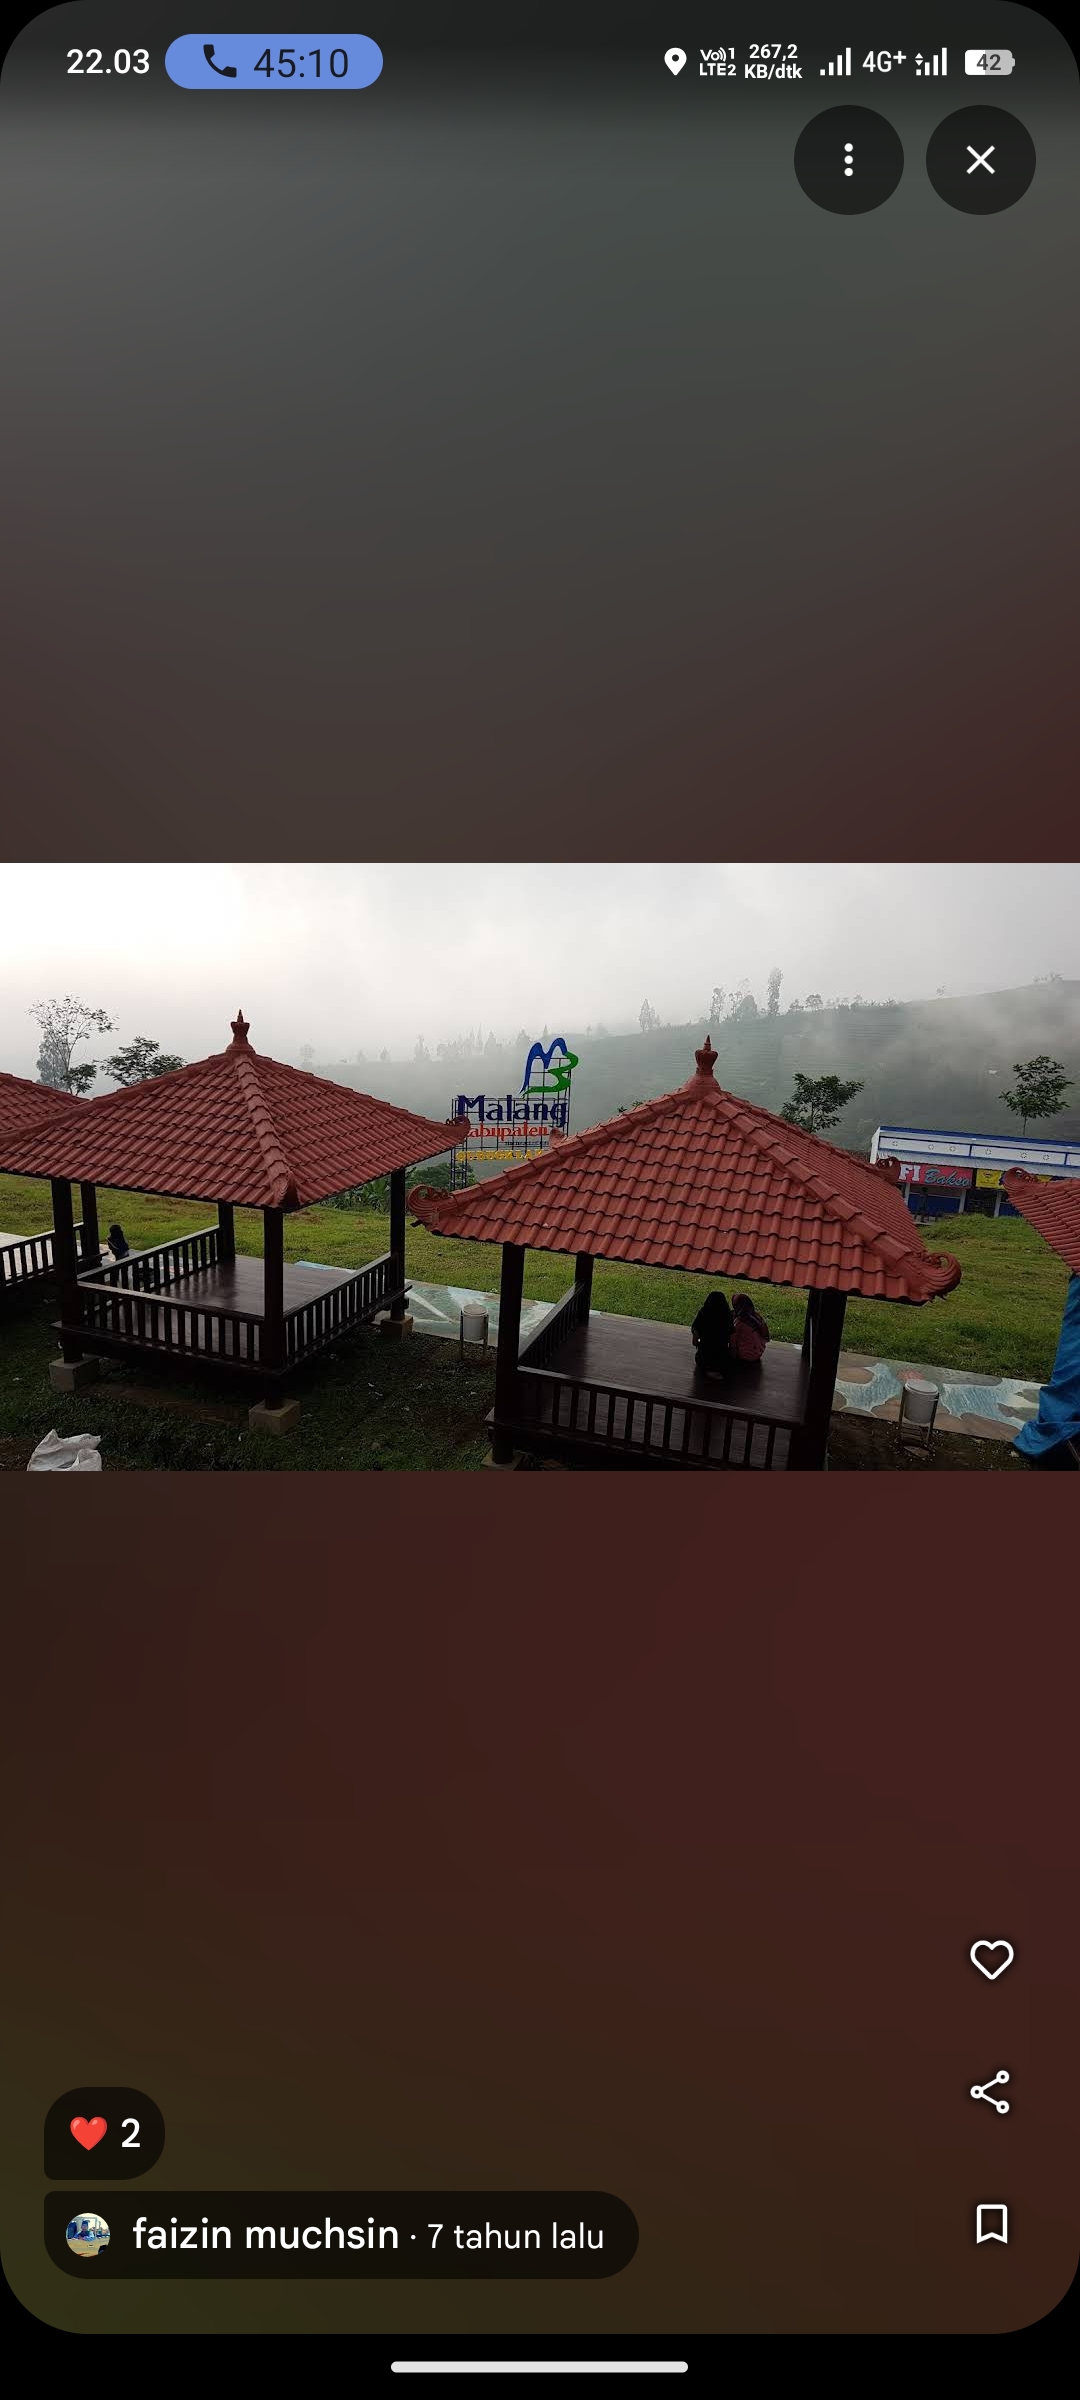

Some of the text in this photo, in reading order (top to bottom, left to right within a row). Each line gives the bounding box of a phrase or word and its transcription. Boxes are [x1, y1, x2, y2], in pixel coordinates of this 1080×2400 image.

[456, 1094, 568, 1128] Malang
[467, 1122, 549, 1141] abupaten
[924, 1168, 971, 1187] Bakso
